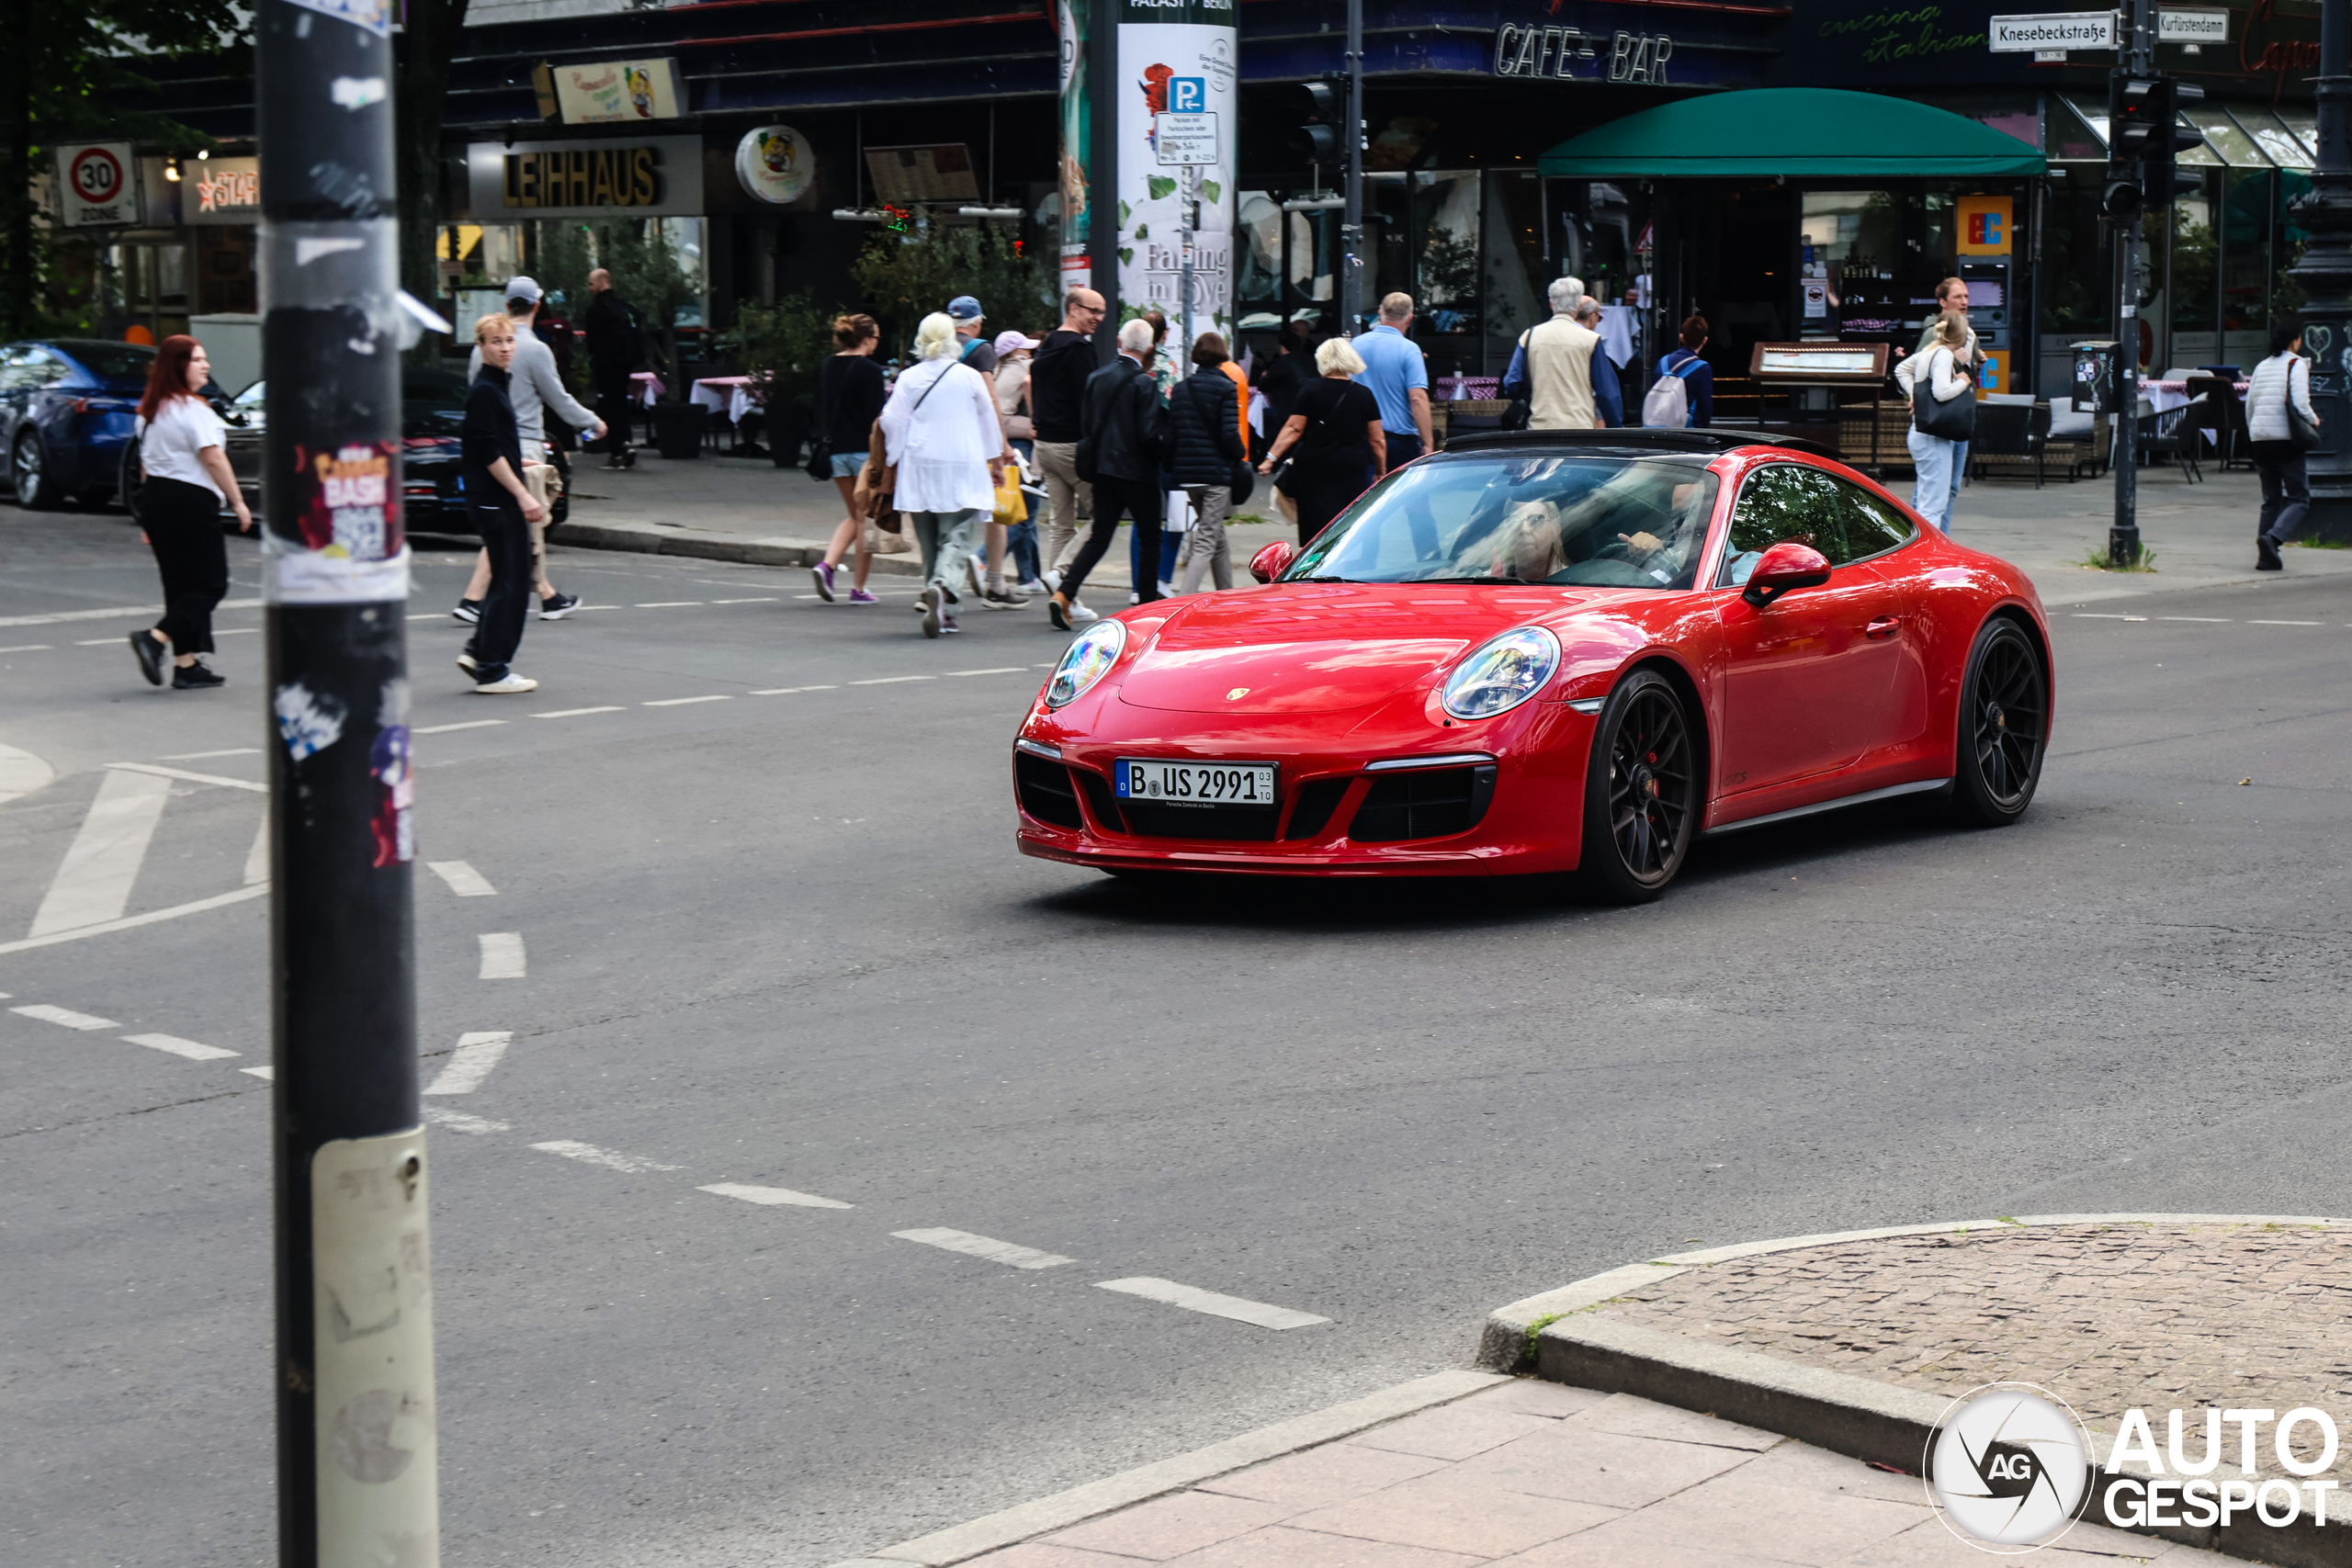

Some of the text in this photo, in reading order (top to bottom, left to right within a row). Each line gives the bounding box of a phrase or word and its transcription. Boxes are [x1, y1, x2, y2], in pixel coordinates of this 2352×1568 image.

[1817, 5, 1942, 38] cucina
[2160, 14, 2223, 32] Kurfürstendamm
[1862, 22, 1990, 62] italian
[1999, 23, 2107, 42] Knesebeckstraße
[1608, 29, 1672, 86] BAR
[81, 162, 112, 189] 30
[503, 146, 655, 209] LEIHHAUS
[80, 206, 120, 222] ZONE
[1144, 242, 1227, 278] Faling
[1145, 278, 1167, 299] in
[1120, 782, 1126, 791] D
[1131, 765, 1257, 800] B US 2991
[1259, 772, 1272, 781] 03
[1724, 772, 1748, 786] GTS
[1260, 791, 1271, 800] 10
